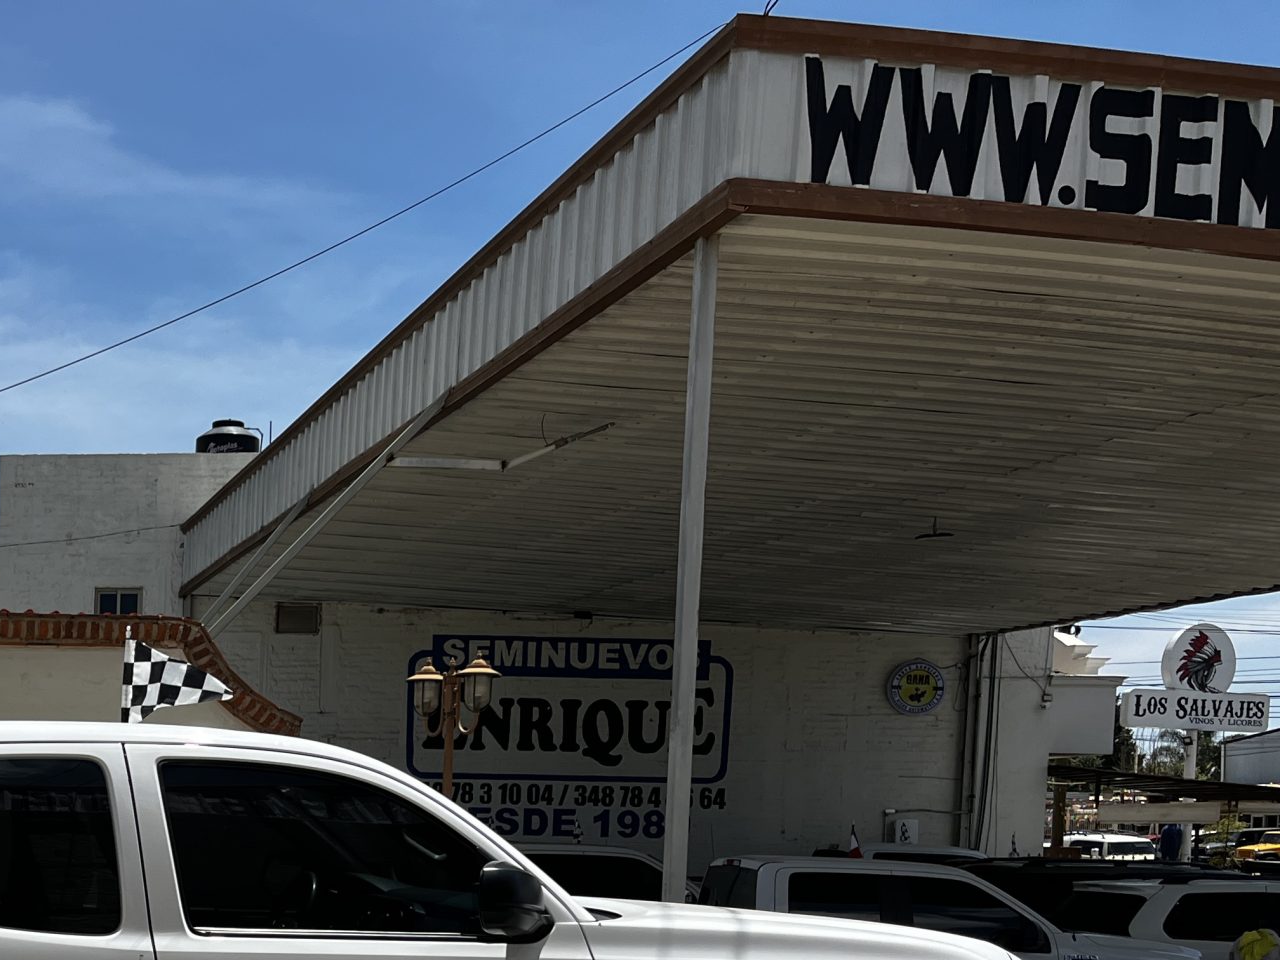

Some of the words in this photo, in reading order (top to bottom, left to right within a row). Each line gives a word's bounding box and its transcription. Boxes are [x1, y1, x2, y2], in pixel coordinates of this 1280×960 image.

[442, 639, 700, 671] SEMINUEVO
[1134, 695, 1168, 717] LOS
[1175, 697, 1265, 719] SALVAJES
[1189, 717, 1215, 725] VINOS
[1228, 719, 1263, 727] LICORES
[480, 783, 492, 804] 3
[498, 783, 521, 805] 10
[527, 784, 554, 806] 04
[574, 785, 615, 807] 348
[620, 786, 643, 808] 78
[647, 787, 662, 808] 4
[700, 787, 726, 810] 64
[468, 807, 577, 836] ESDE
[593, 809, 690, 839] 198
